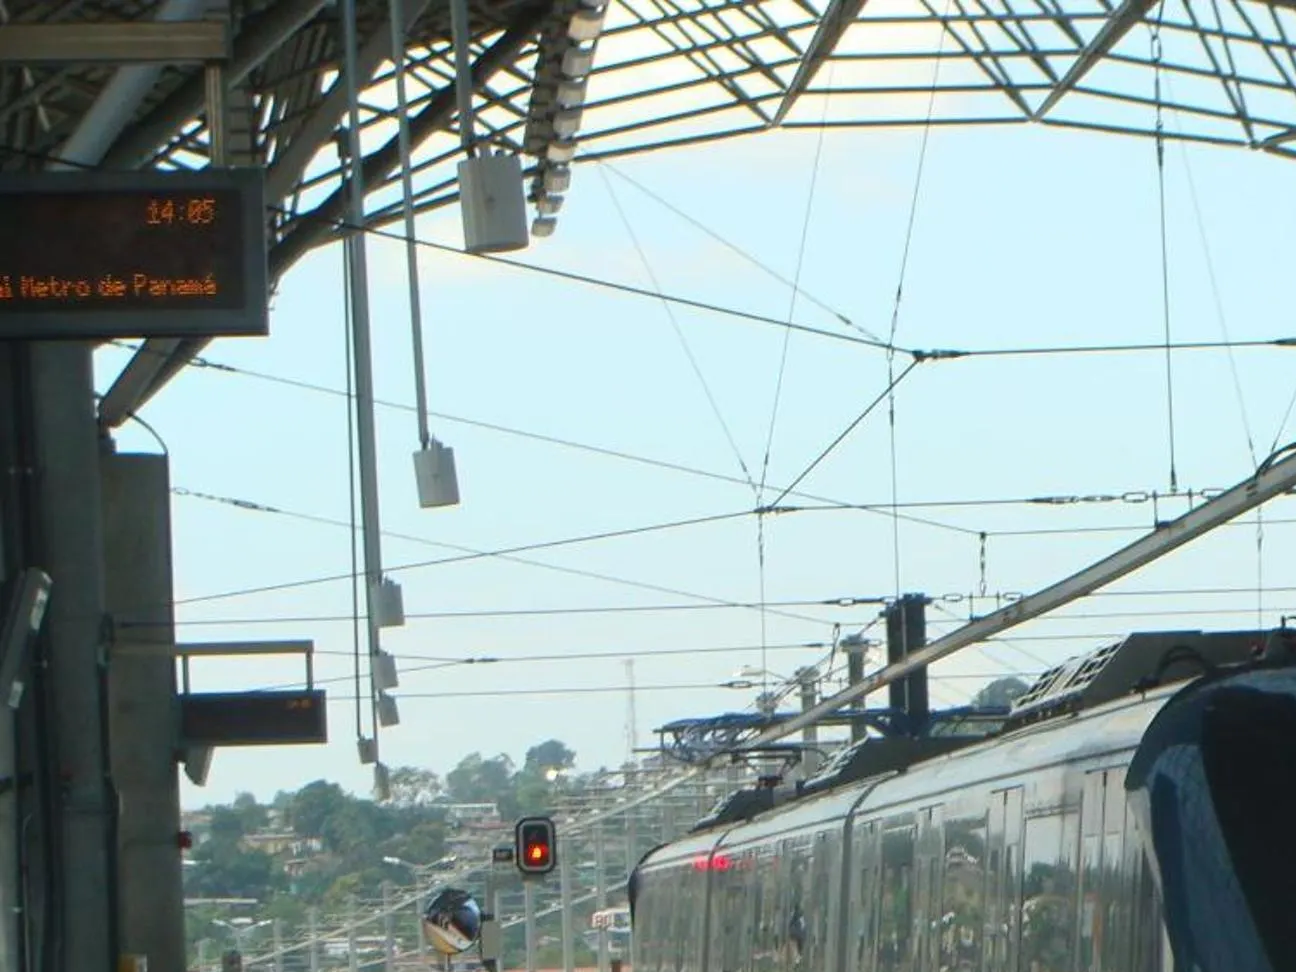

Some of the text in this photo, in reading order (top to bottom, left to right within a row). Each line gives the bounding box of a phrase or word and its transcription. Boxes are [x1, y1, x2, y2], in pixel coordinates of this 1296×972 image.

[147, 199, 216, 224] 14:05
[20, 275, 91, 297] Metro
[99, 273, 127, 297] de
[133, 272, 217, 297] Panamá
